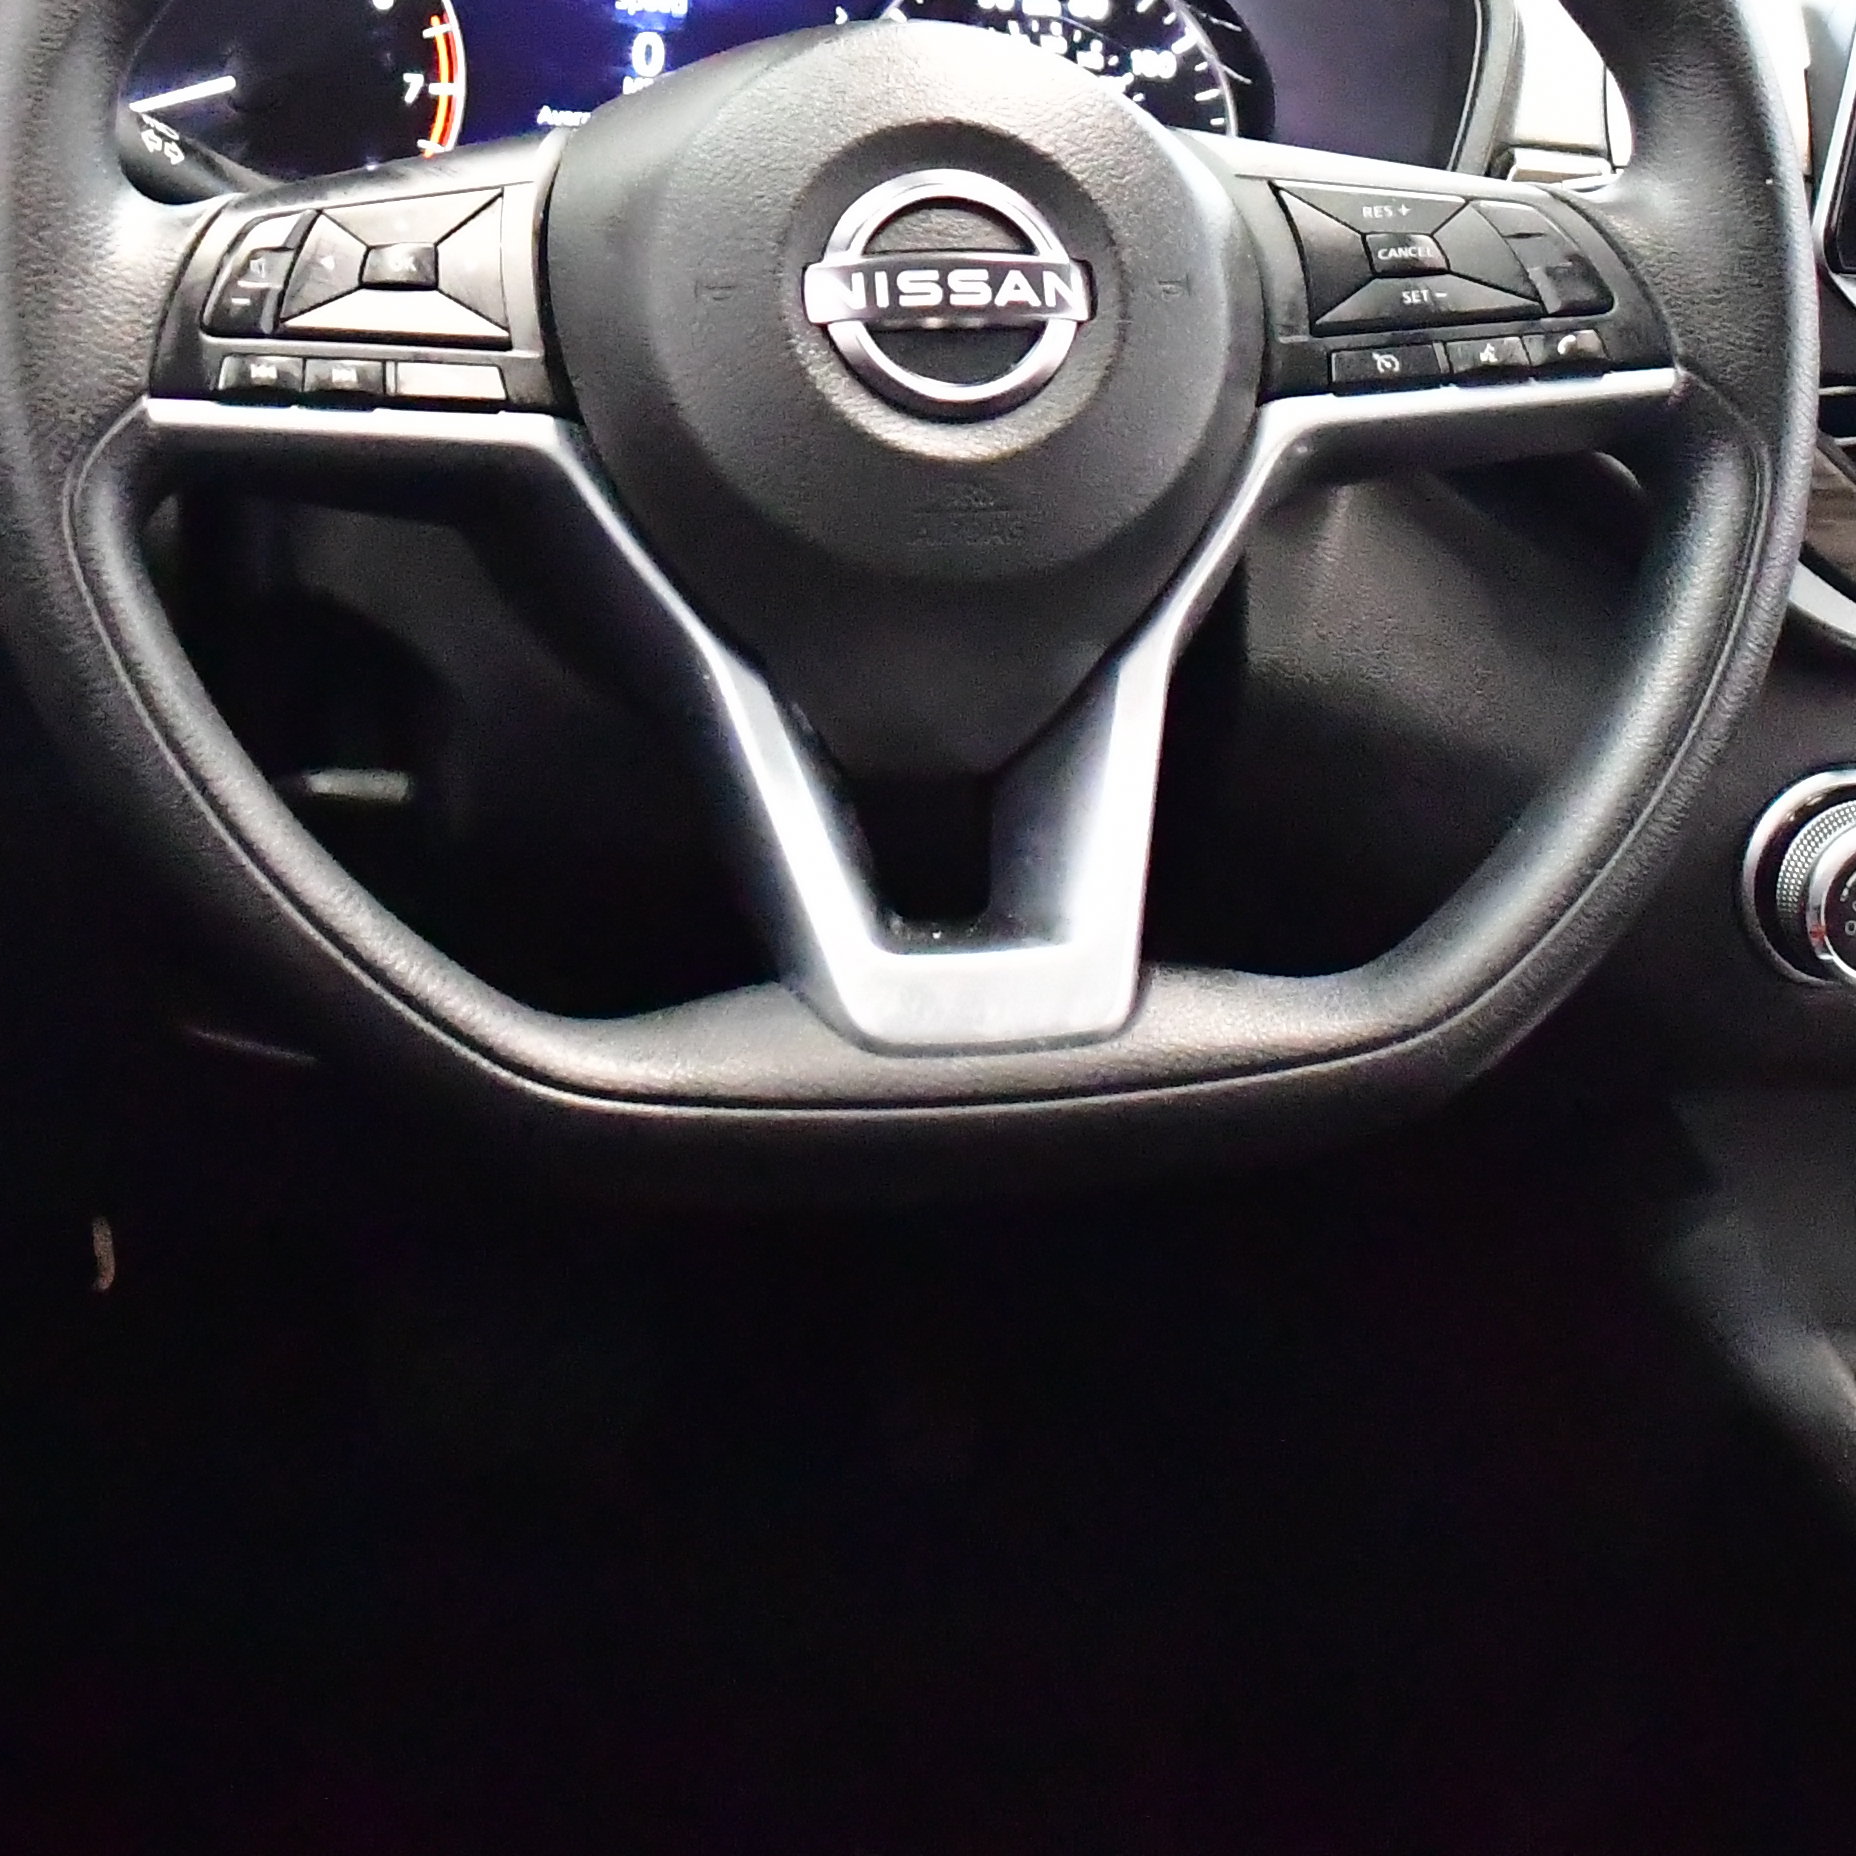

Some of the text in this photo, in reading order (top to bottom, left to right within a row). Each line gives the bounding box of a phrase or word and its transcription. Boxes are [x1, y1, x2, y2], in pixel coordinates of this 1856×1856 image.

[631, 31, 666, 78] 0
[403, 73, 424, 104] 7
[1362, 204, 1393, 220] RES
[1377, 245, 1434, 261] CANCEL
[828, 268, 1082, 311] NISSAN
[1401, 289, 1430, 305] SET
